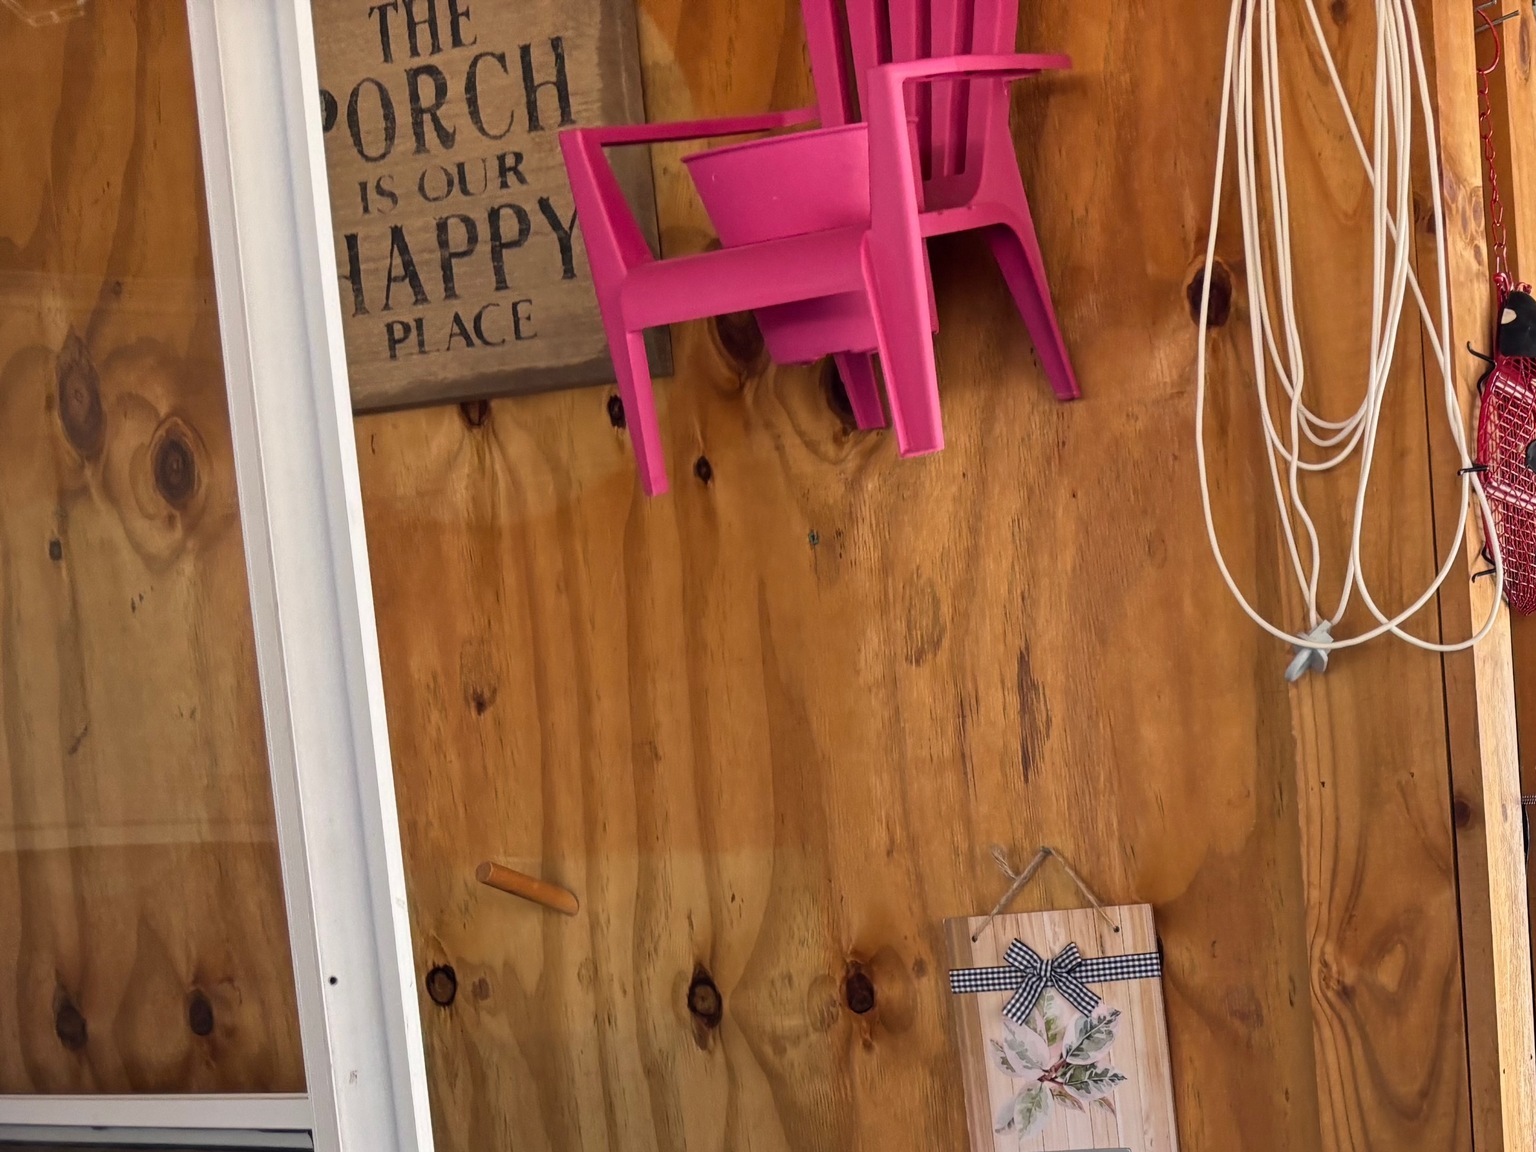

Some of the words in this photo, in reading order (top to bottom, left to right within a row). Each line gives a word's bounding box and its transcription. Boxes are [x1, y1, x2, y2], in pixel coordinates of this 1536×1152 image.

[367, 0, 478, 64] THE
[358, 174, 399, 217] IS
[417, 150, 530, 202] OUR
[384, 298, 538, 361] PLACE
